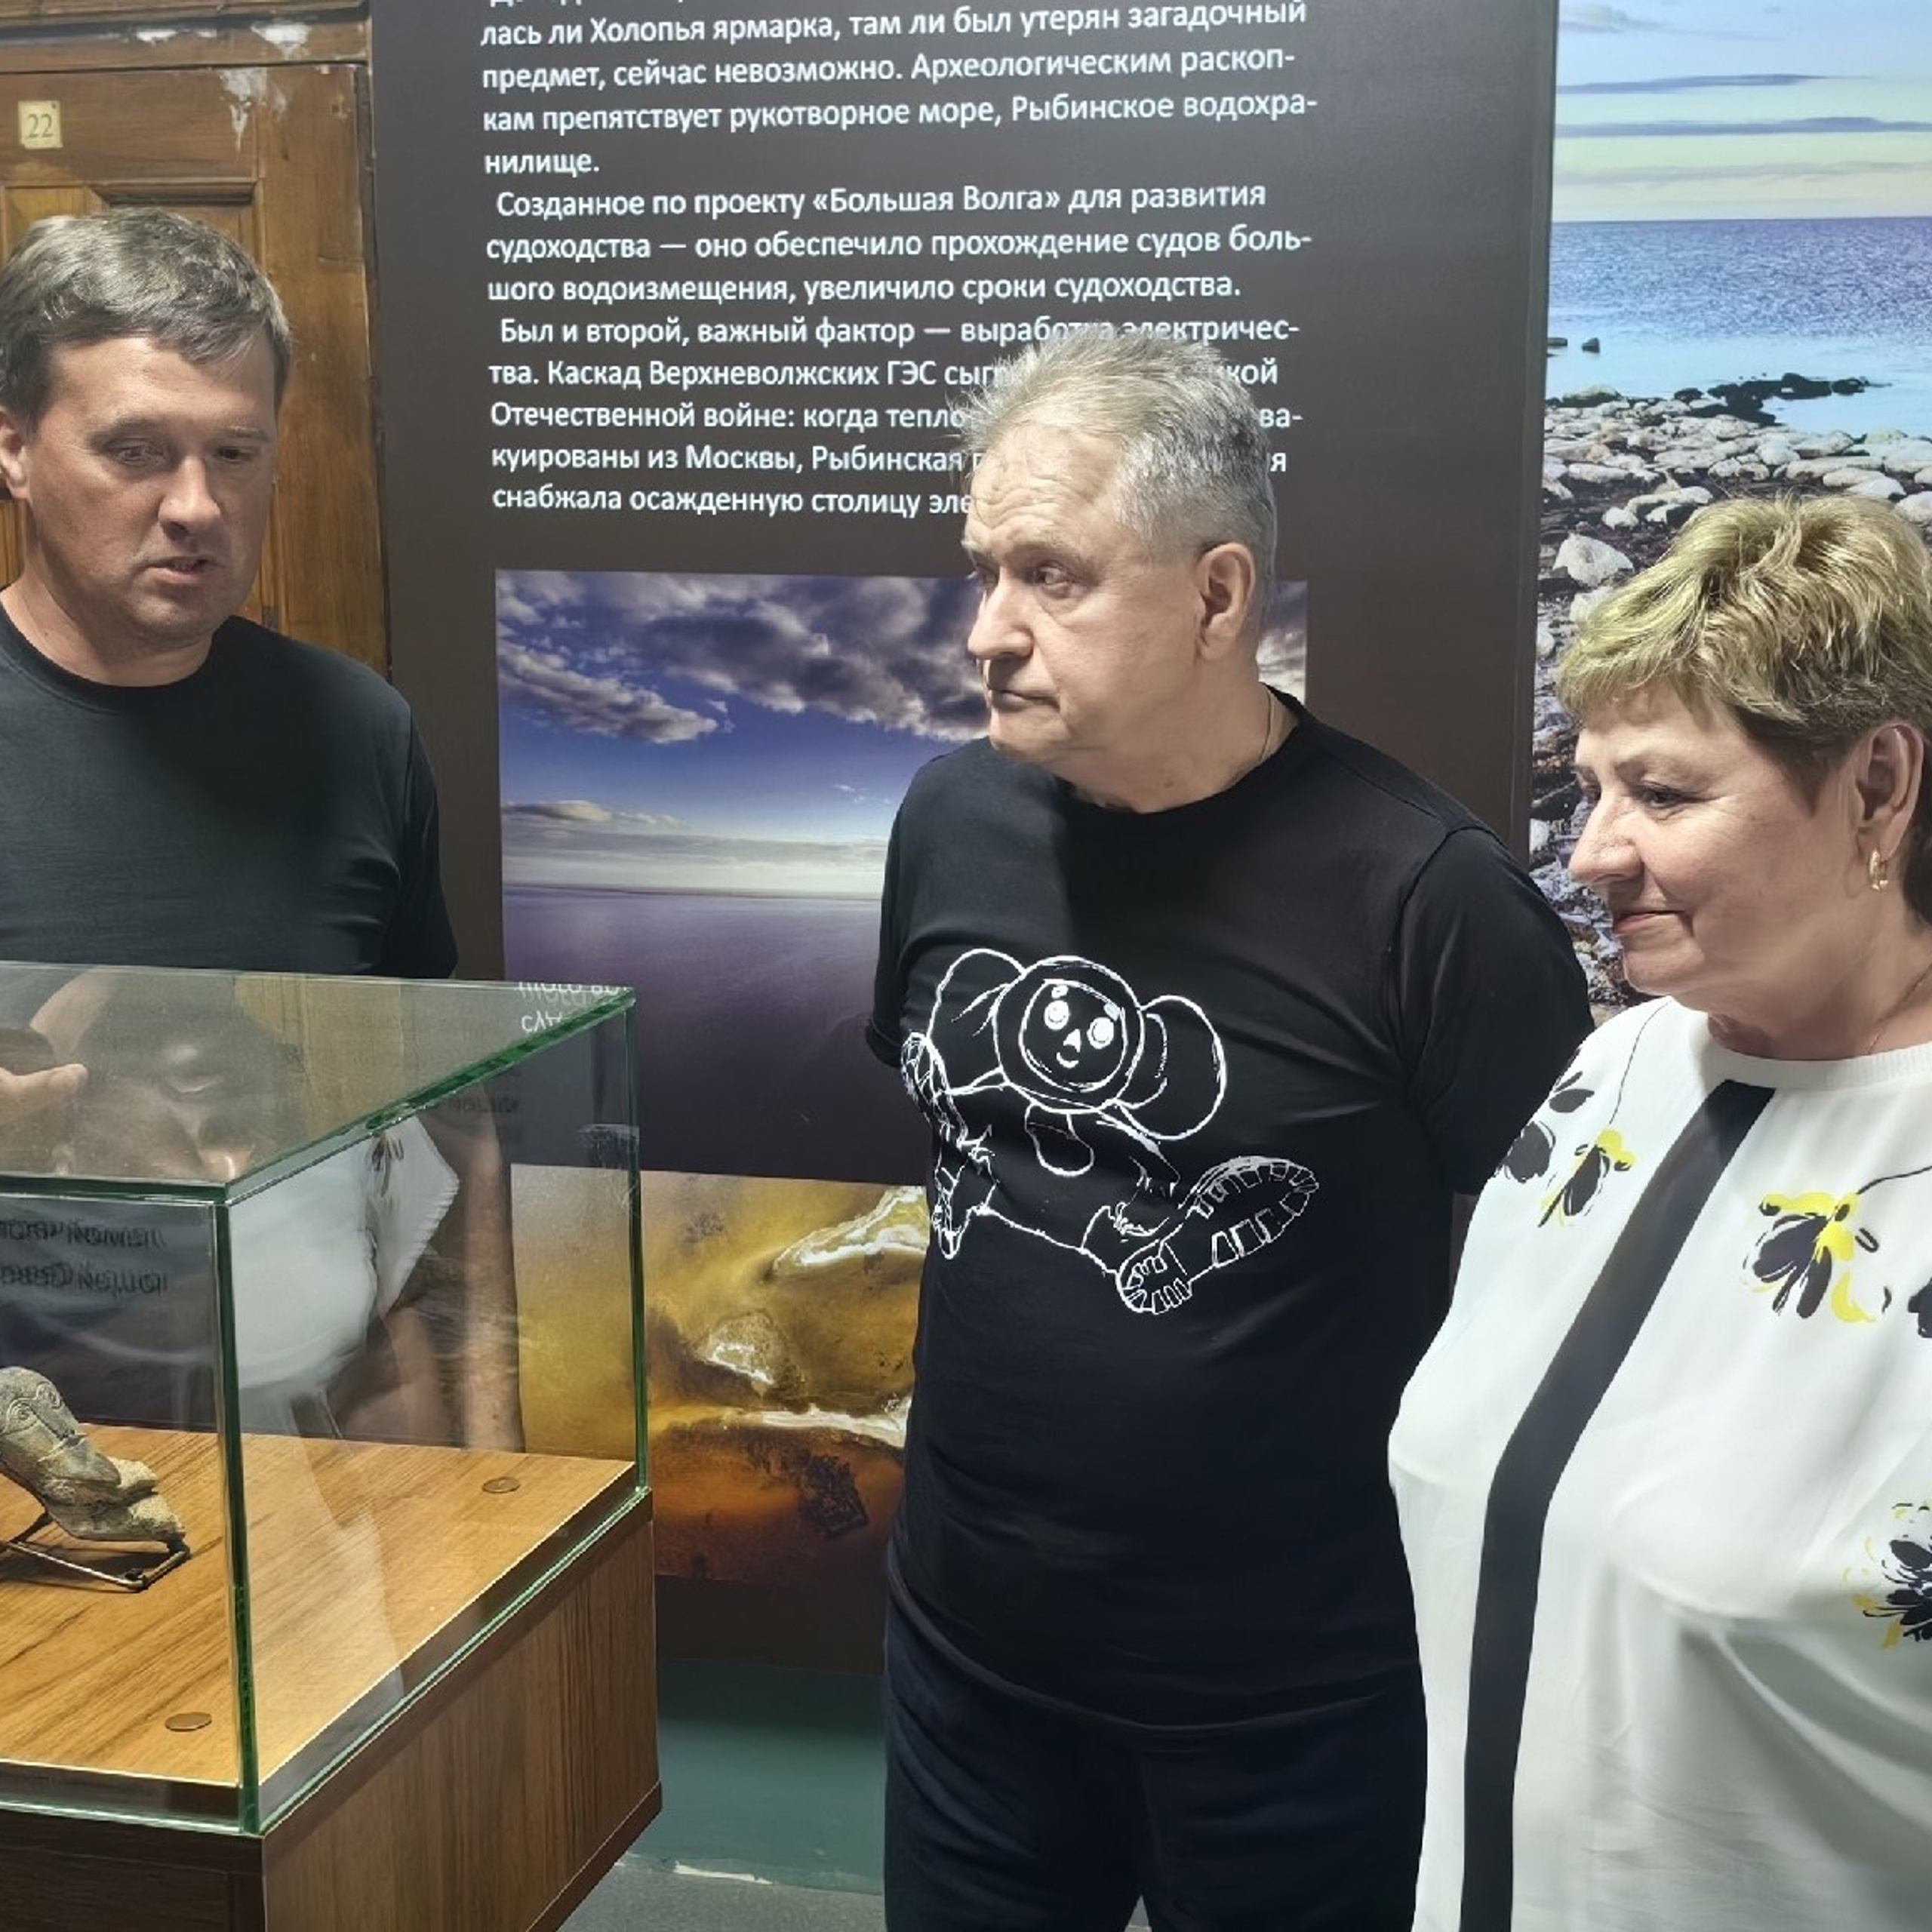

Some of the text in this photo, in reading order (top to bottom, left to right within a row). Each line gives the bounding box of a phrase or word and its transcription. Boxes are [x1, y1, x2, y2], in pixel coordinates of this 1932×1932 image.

[480, 0, 1306, 47] лась ли Холопья ярмарка, там ли был утерян загадочный
[482, 48, 1295, 95] предмет, сейчас невозможно. Археологическим раскоп-
[26, 113, 53, 139] 22
[483, 93, 1318, 137] кам препятствует рукотворное море, Рыбинское водохра-
[484, 153, 600, 178] нилище.
[496, 185, 1266, 221] Созданное по проекту «Большая Волга» для развития
[486, 238, 651, 264] судоходства
[694, 237, 748, 258] оно
[754, 229, 923, 257] обеспечило
[931, 233, 1130, 262] прохождение
[1136, 232, 1221, 259] судов
[1229, 223, 1312, 251] боль-
[488, 275, 1241, 306] шого водоизмещения, увеличило сроки судоходства.
[500, 318, 554, 343] Был
[561, 324, 579, 343] и
[586, 315, 691, 349] второй,
[697, 315, 808, 343] важный
[815, 315, 915, 349] фактор
[488, 365, 540, 385] тва.
[548, 360, 642, 391] Каскад
[649, 360, 880, 392] Верхневолжских
[887, 360, 938, 386] ГЭС
[490, 401, 695, 427] Отечественной
[703, 401, 795, 428] войне:
[803, 407, 878, 434] когда
[491, 448, 640, 473] куированы
[648, 451, 679, 469] из
[686, 444, 804, 474] Москвы,
[812, 444, 963, 472] Рыбинская
[491, 482, 622, 510] снабжала
[629, 491, 804, 518] осажденную
[811, 493, 921, 519] столицу
